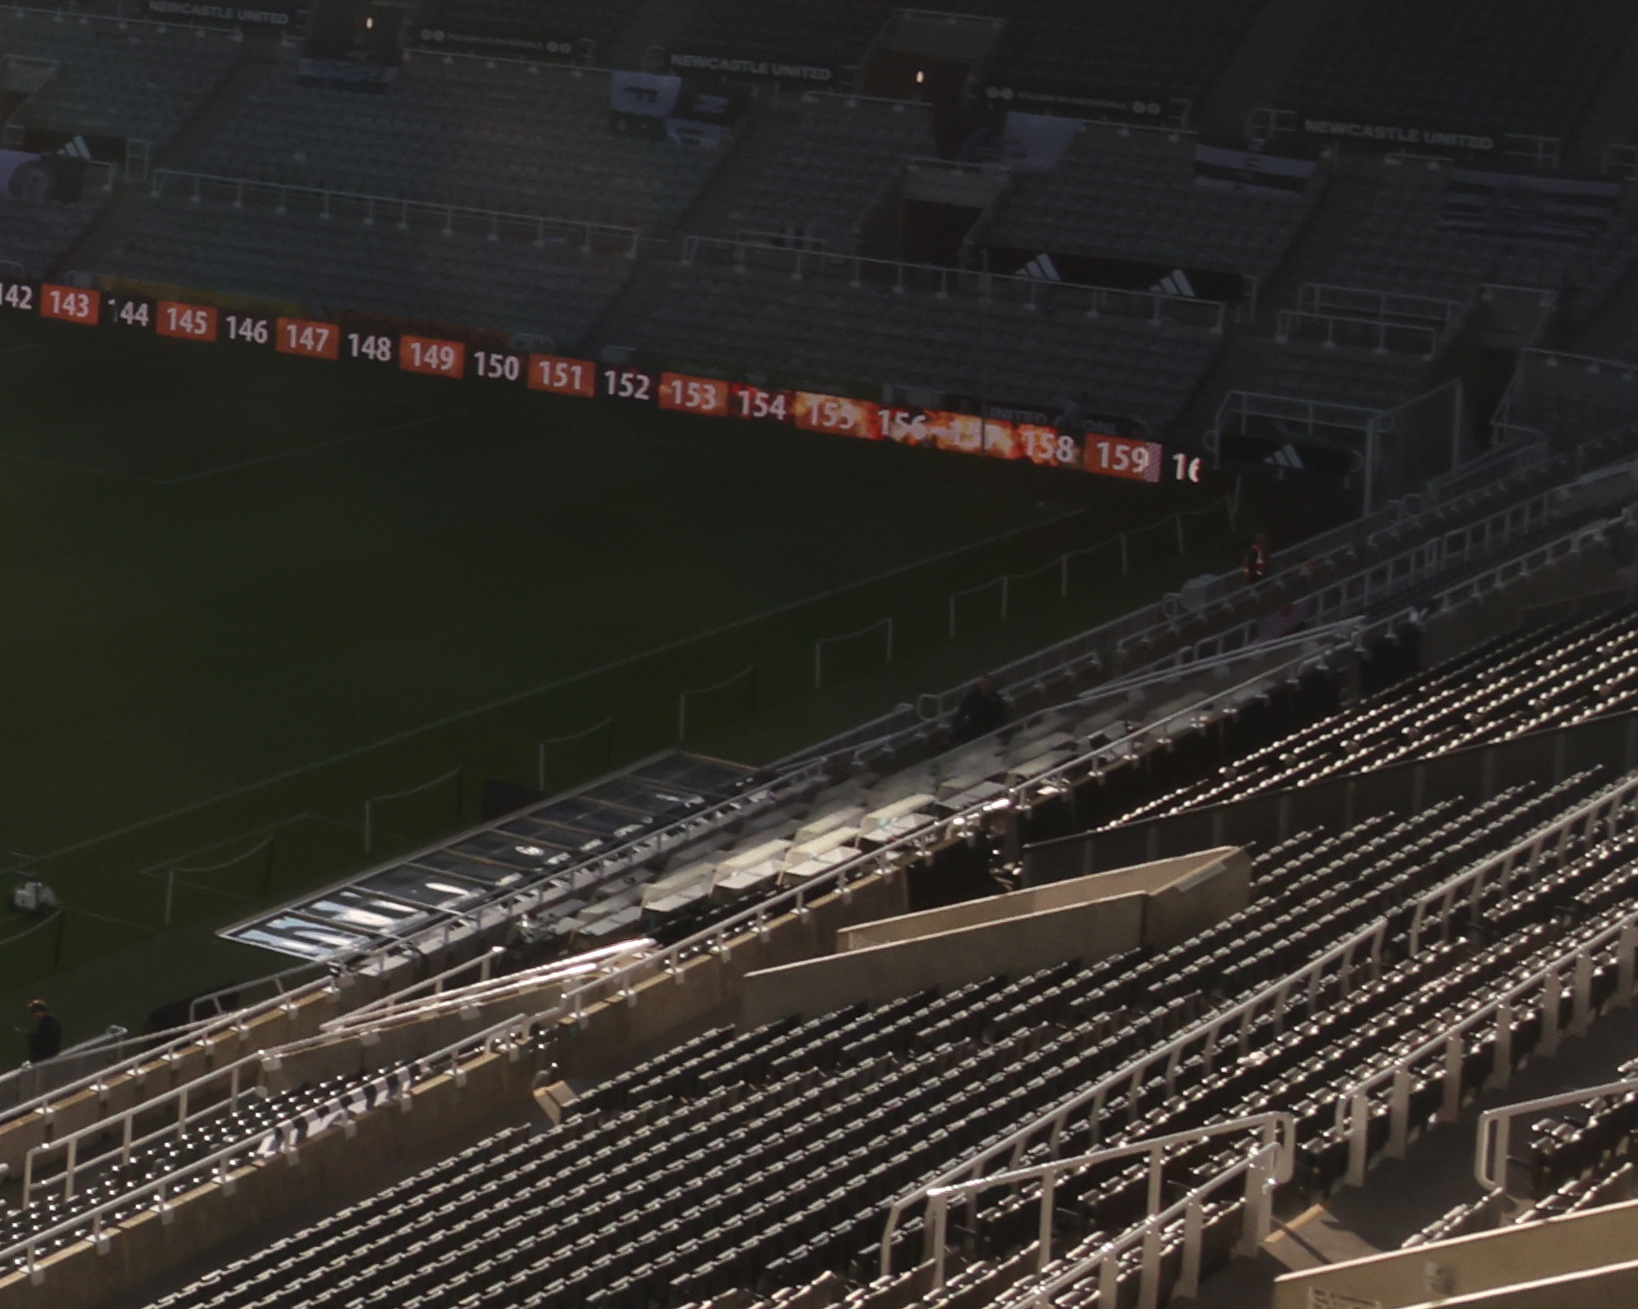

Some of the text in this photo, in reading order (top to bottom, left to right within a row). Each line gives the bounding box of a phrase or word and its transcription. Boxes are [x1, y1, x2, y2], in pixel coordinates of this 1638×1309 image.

[149, 1, 289, 24] NEWCASTLE UNITED
[671, 54, 832, 81] NEWCASTLE UNITED
[1304, 119, 1494, 150] NEWCASTLE UNITED
[51, 291, 89, 317] 143
[168, 308, 207, 334] 145
[226, 316, 267, 343] 146
[287, 324, 329, 351] 147
[348, 334, 391, 361] 148
[411, 342, 455, 370] 149
[475, 352, 519, 380] 150
[539, 361, 582, 389] 151
[605, 371, 649, 399] 152
[671, 377, 717, 411] 153
[737, 388, 786, 422] 154
[1022, 431, 1074, 462] 158
[1097, 442, 1148, 473] 159
